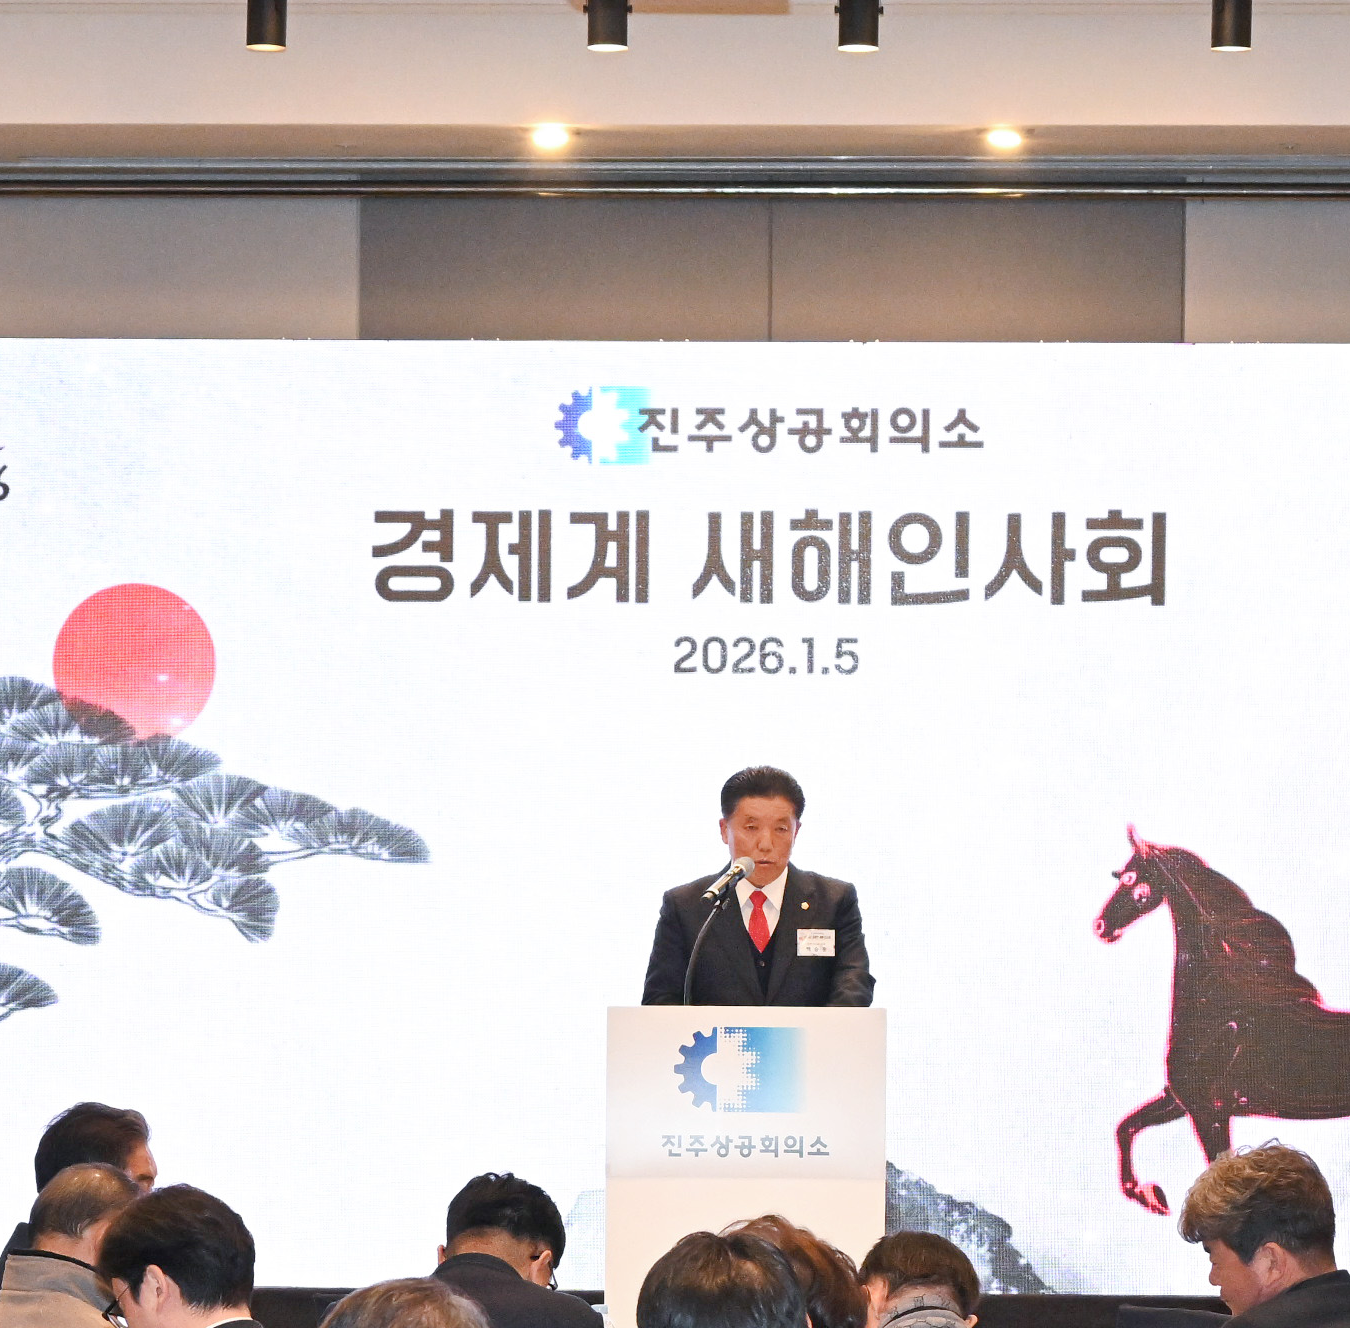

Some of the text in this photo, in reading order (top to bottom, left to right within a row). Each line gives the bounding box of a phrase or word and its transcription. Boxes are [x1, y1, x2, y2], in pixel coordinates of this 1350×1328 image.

[637, 406, 984, 454] 진주상공회의소
[371, 508, 1167, 606] 경제계 새해인사회
[673, 636, 860, 675] 2026.1.5
[661, 1134, 830, 1158] 진주상공회의소
